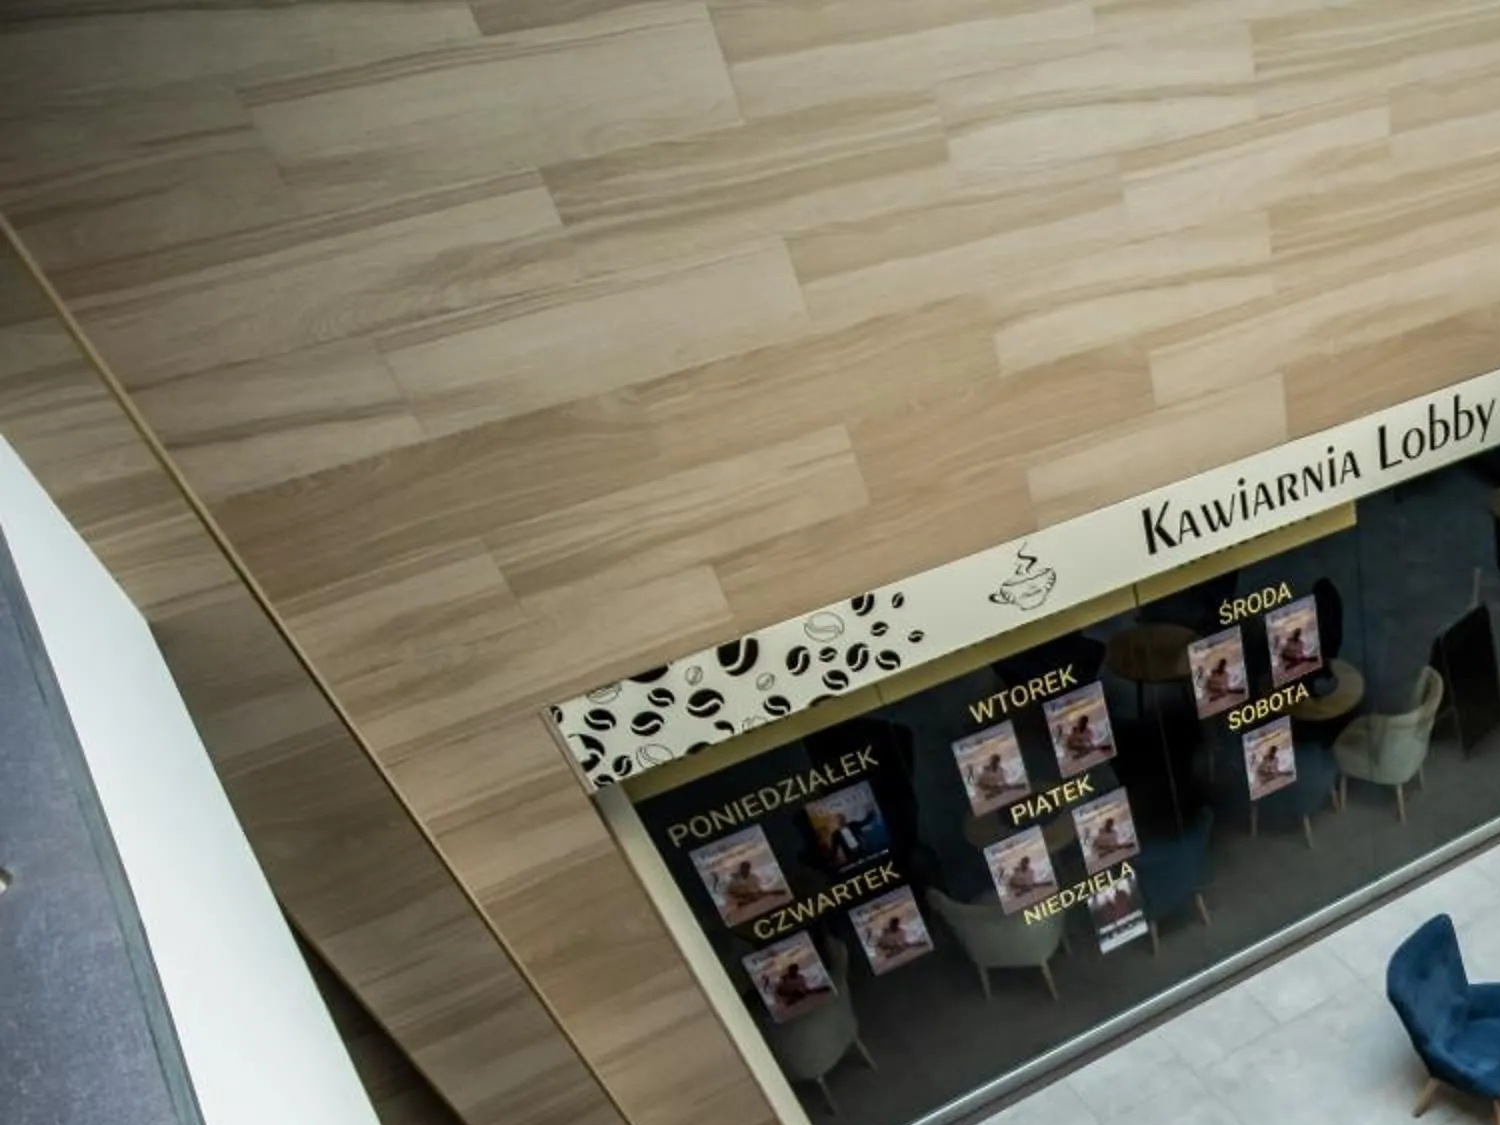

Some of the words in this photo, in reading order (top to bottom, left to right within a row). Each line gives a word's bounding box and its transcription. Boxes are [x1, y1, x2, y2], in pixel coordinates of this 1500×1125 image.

[1377, 394, 1497, 469] Lobby
[1219, 581, 1293, 625] ŚRODA
[968, 664, 1078, 724] WTOREK
[1228, 682, 1309, 730] SOBOTA
[667, 745, 880, 848] PONIEDZIAŁEK
[753, 861, 901, 941] CZWARTEK
[1023, 861, 1136, 925] NIEDZIELA
